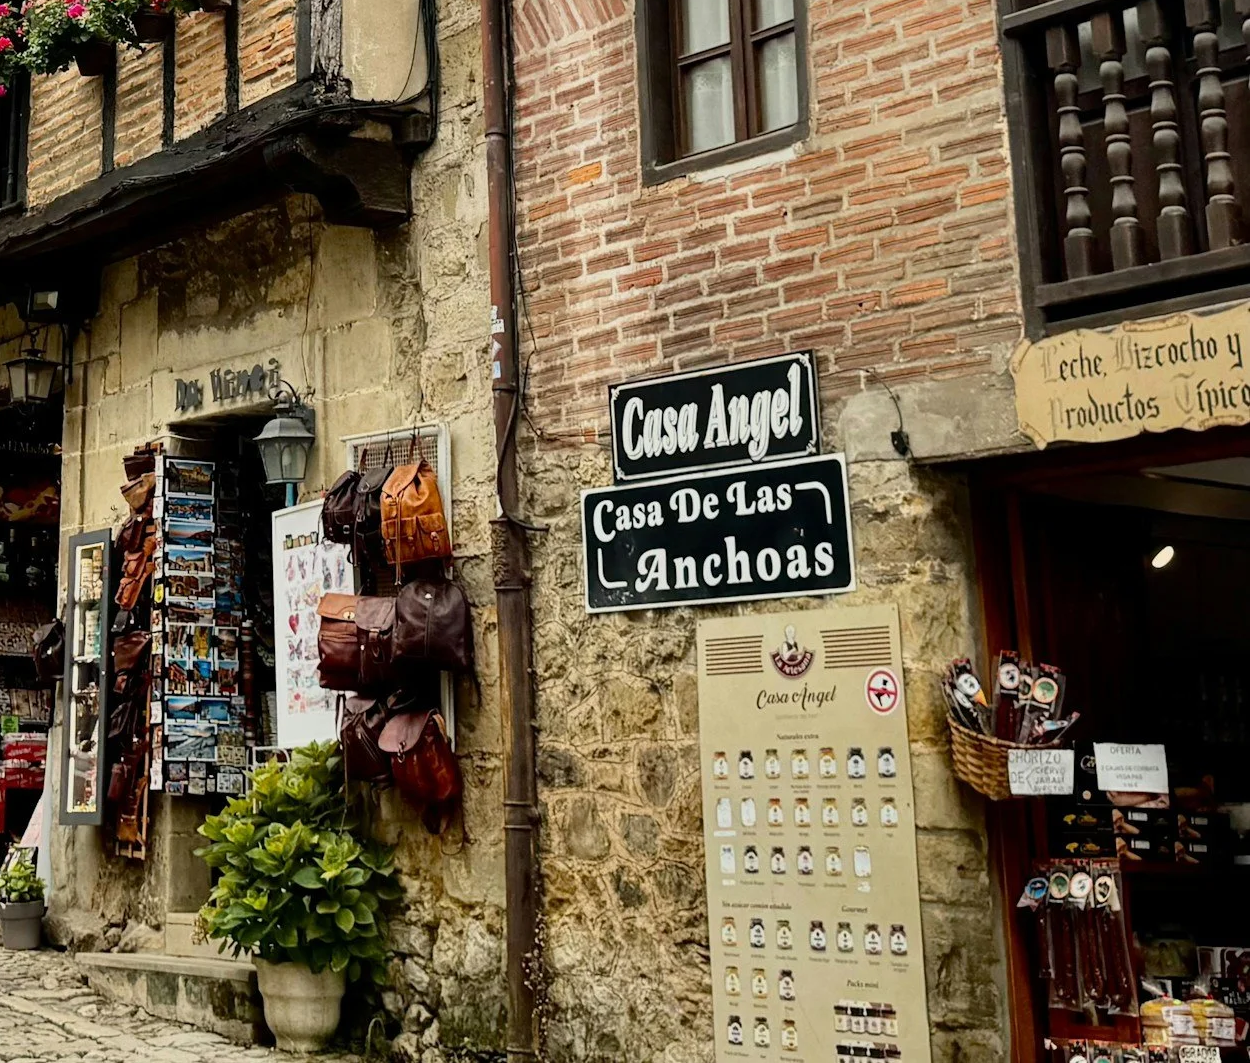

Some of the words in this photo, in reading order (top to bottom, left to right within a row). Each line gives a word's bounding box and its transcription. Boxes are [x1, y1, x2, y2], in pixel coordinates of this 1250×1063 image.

[1227, 333, 1244, 370] y
[621, 396, 700, 460] Casa
[703, 362, 804, 462] Angel
[1049, 382, 1161, 437] Productos
[593, 499, 664, 543] Casa
[670, 488, 720, 524] De
[726, 480, 793, 516] Las
[635, 536, 835, 593] Anchoas
[756, 689, 789, 710] Casa
[1008, 751, 1061, 765] CHORIZO
[1110, 746, 1142, 755] OFERTA
[841, 905, 868, 914] Gourmet
